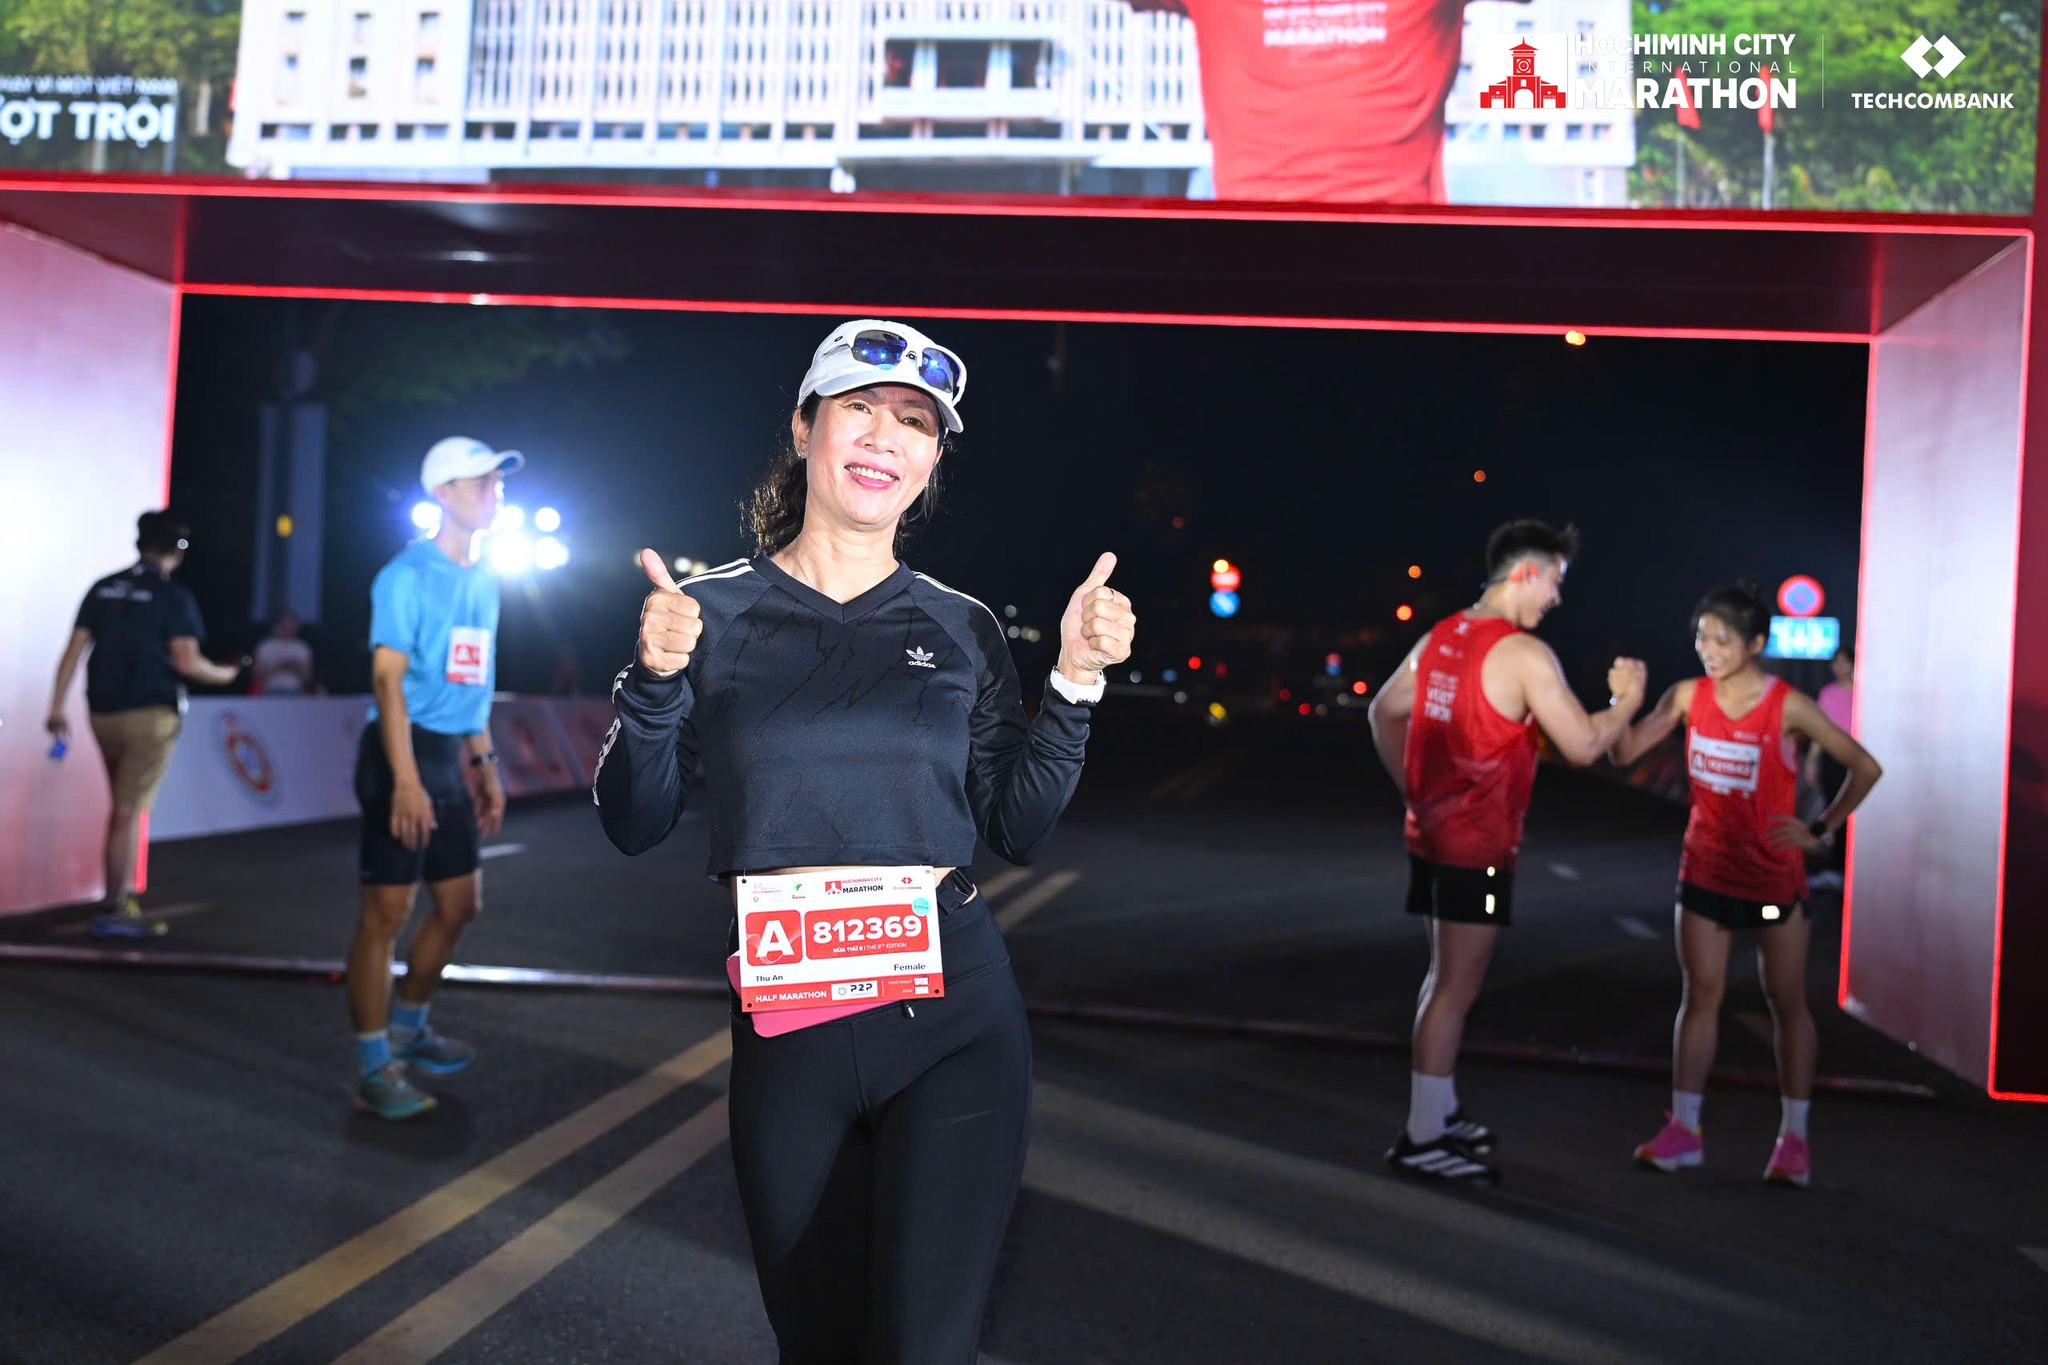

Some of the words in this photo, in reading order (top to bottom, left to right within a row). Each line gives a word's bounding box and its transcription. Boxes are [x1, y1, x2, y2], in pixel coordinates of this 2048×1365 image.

[0, 95, 62, 145] ỢT
[908, 660, 936, 668] adidas
[842, 884, 884, 893] MARATHON
[812, 914, 922, 945] 812369
[755, 919, 795, 958] A
[893, 962, 926, 971] Female
[755, 974, 771, 982] Thu
[850, 983, 873, 992] P2P
[755, 993, 777, 1003] HALF
[779, 990, 827, 1000] MARATHON
